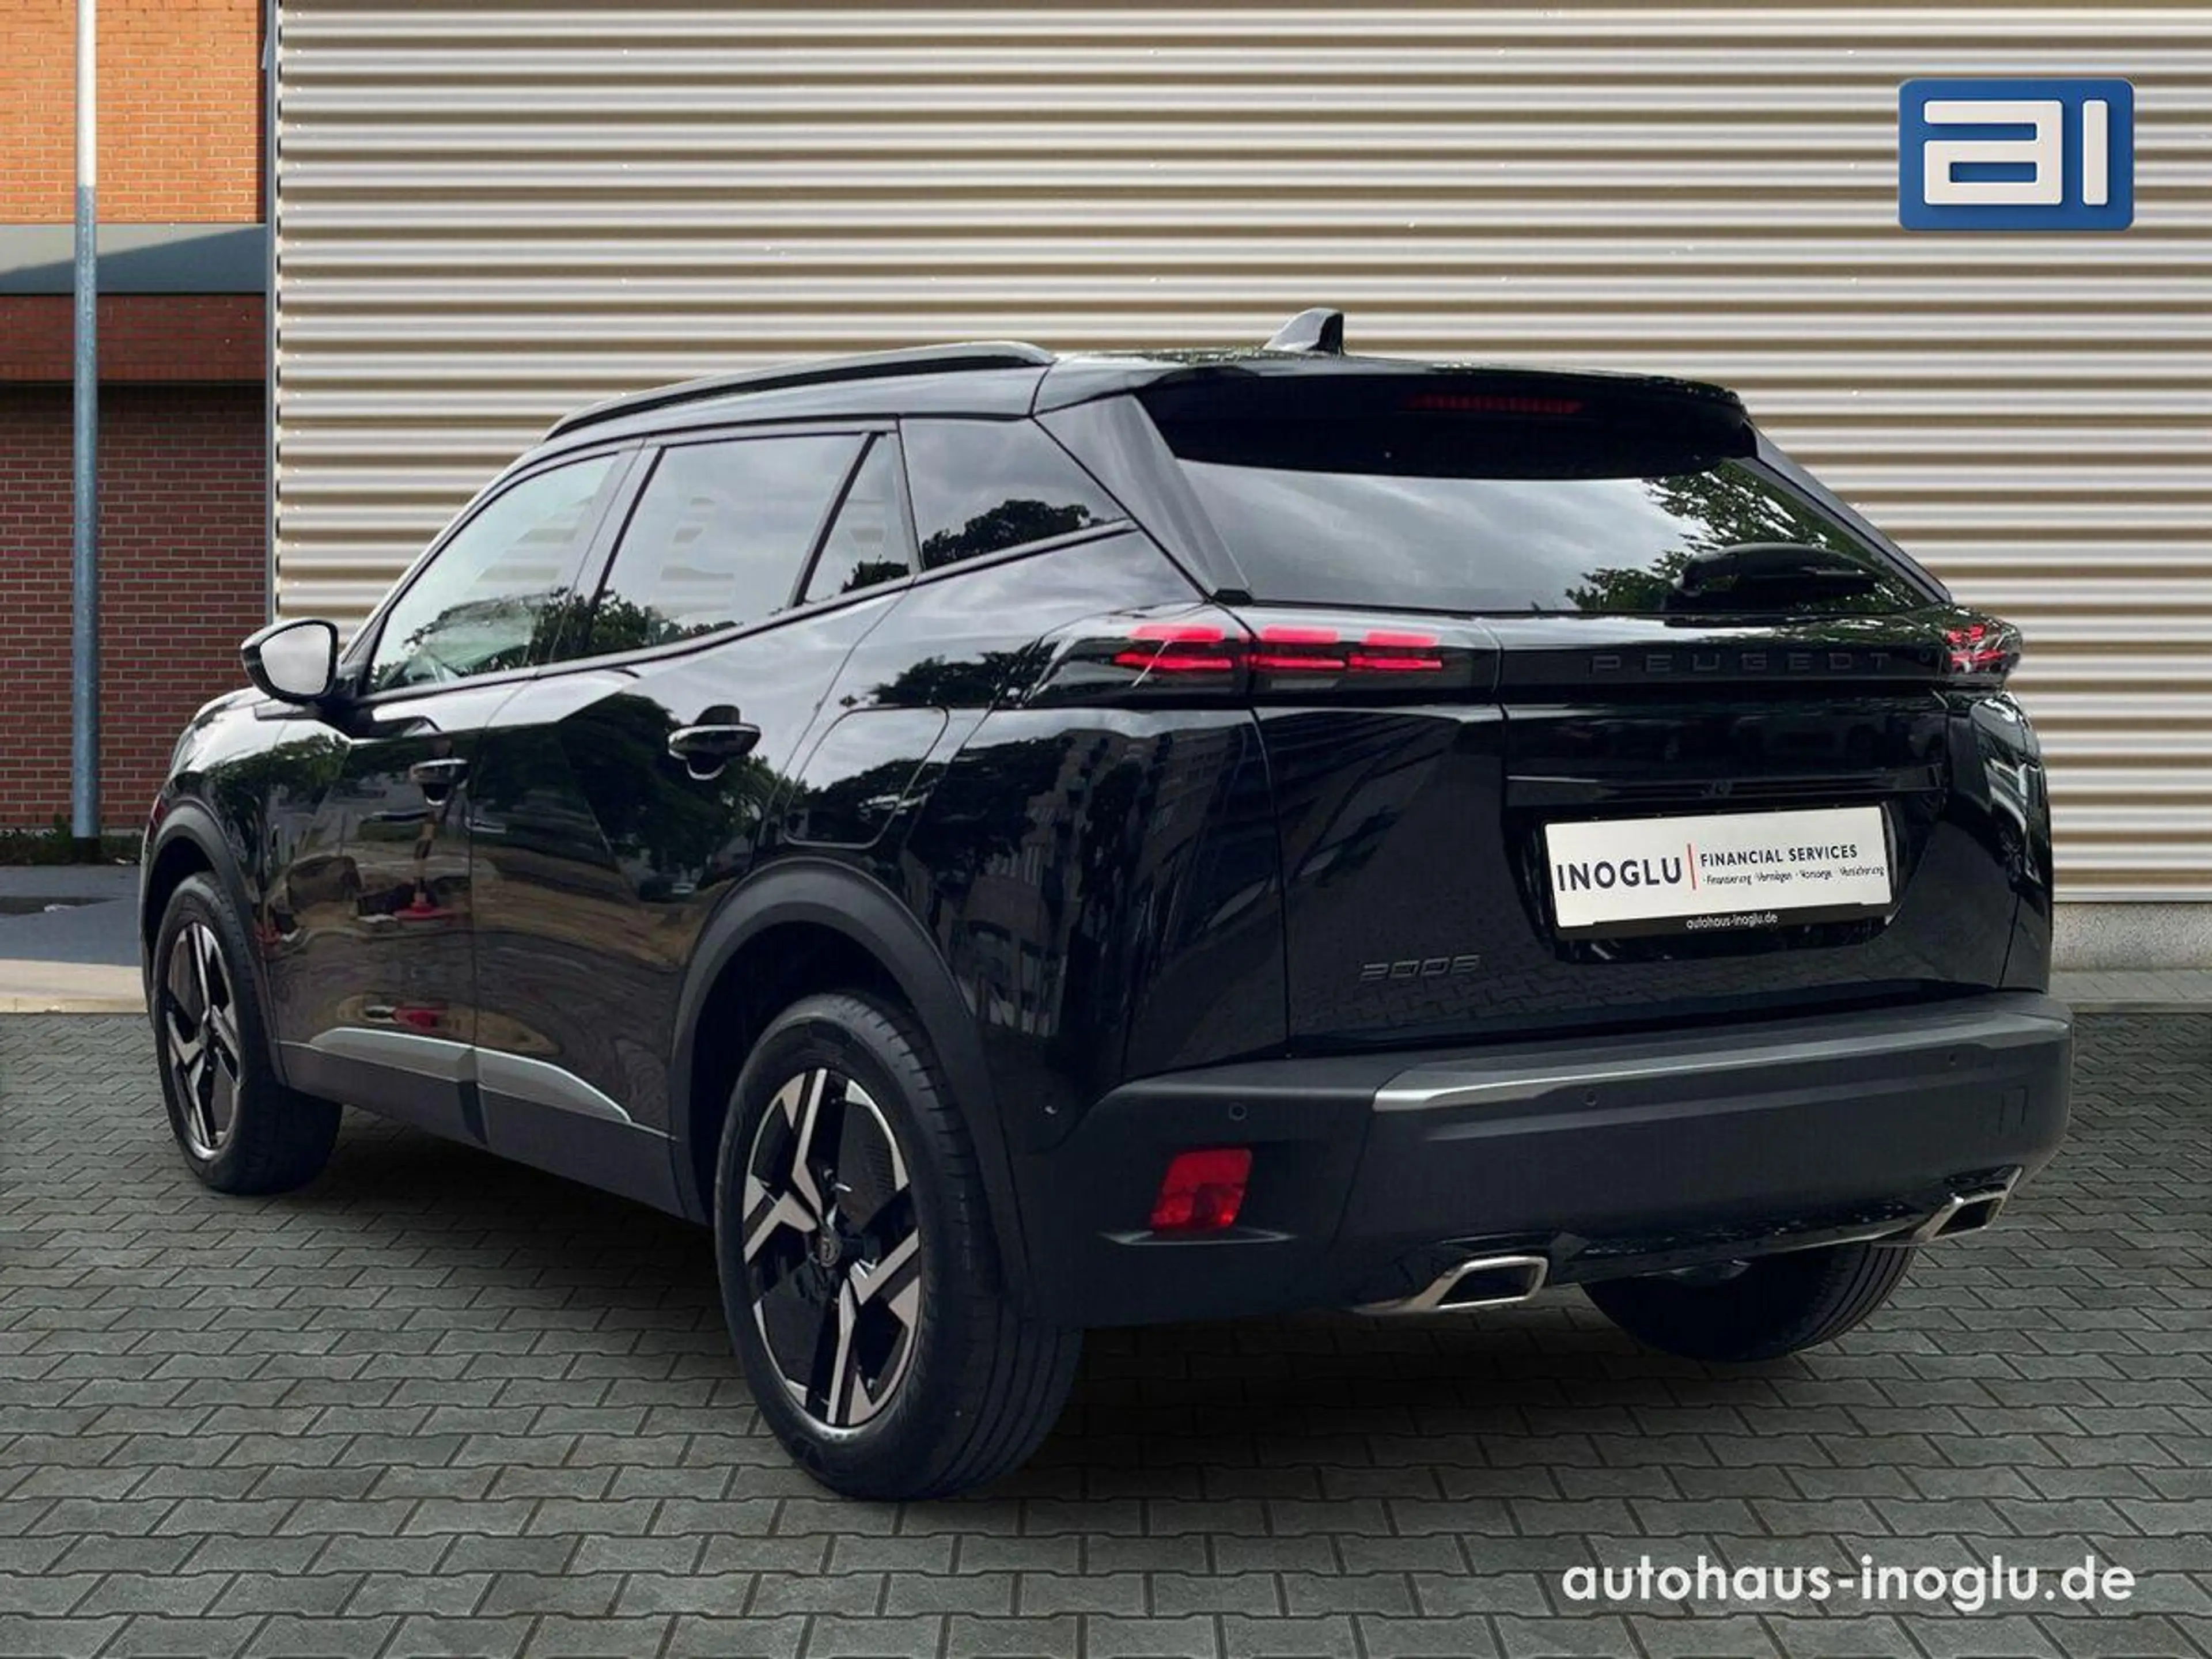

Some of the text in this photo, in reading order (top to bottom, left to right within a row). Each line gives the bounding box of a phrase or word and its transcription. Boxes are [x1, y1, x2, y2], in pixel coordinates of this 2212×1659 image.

[1590, 652, 1892, 675] PEUGEOT
[1700, 844, 1858, 867] FINANCIAL SERVICES
[1558, 857, 1683, 891] INOGLU
[1686, 911, 1778, 930] autohaus-inoglu.de
